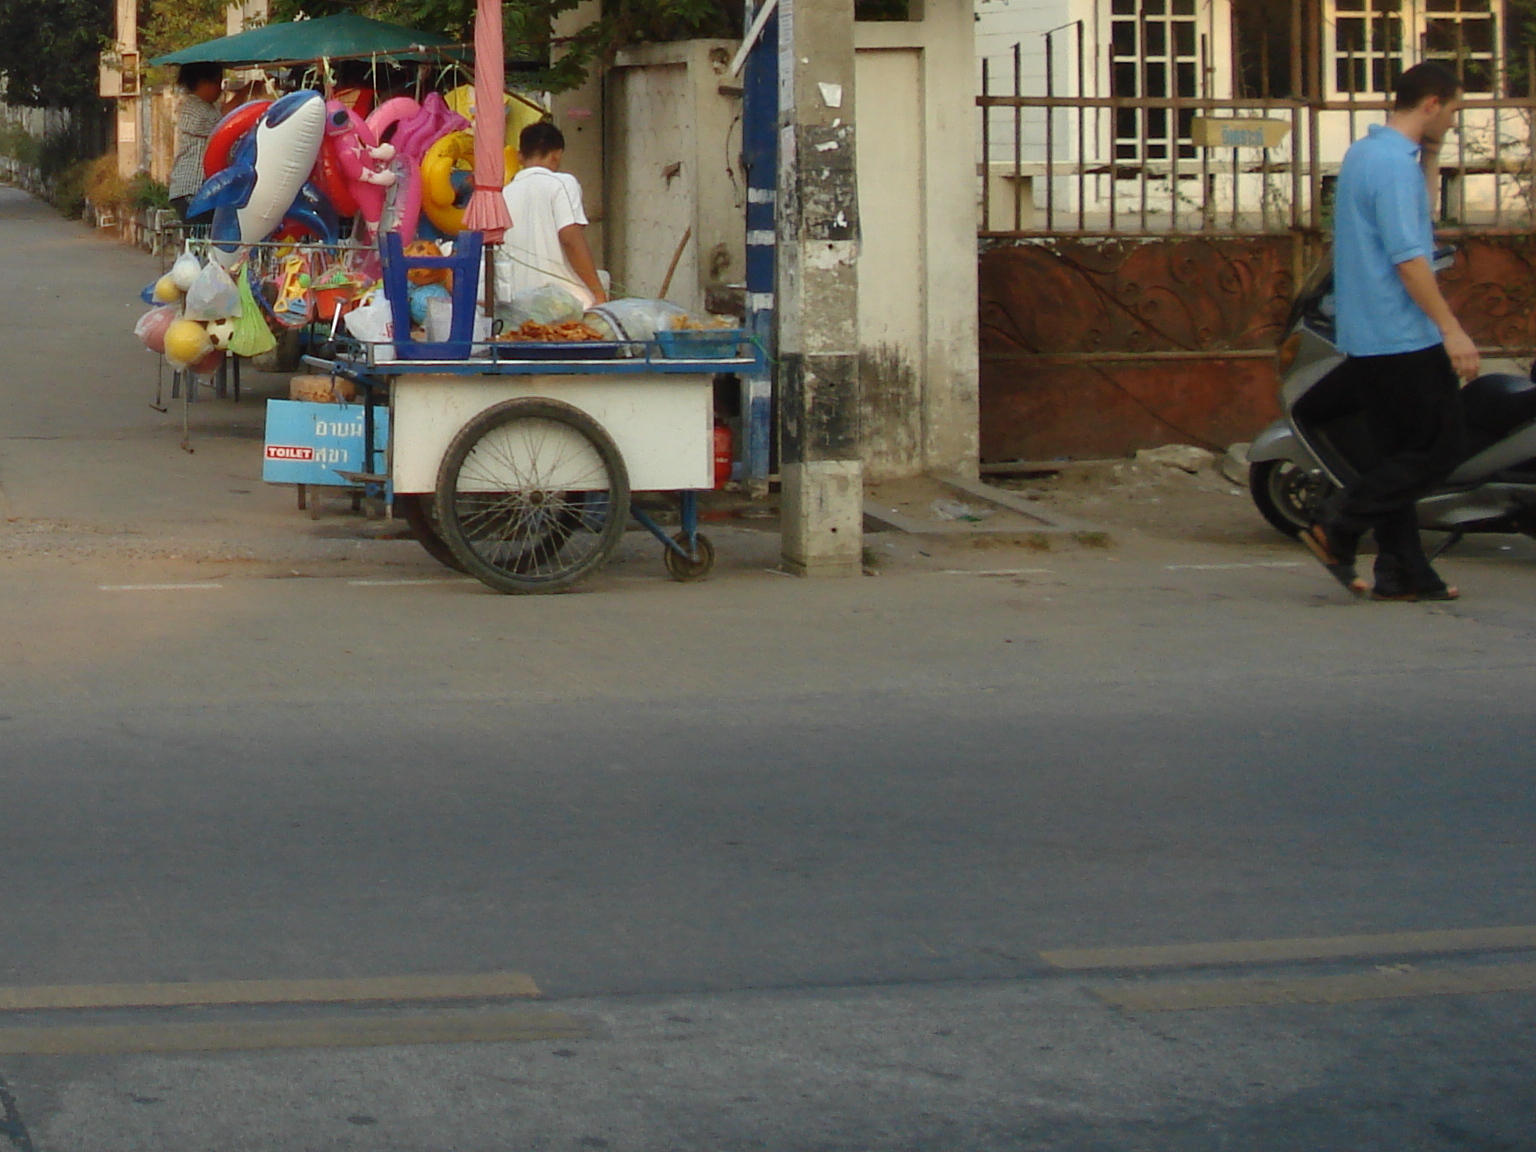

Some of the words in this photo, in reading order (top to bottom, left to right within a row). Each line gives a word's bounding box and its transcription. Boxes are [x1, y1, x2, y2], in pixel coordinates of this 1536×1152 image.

[316, 410, 365, 436] อาบน้
[268, 447, 312, 459] TOILET
[315, 448, 348, 469] สุขา
